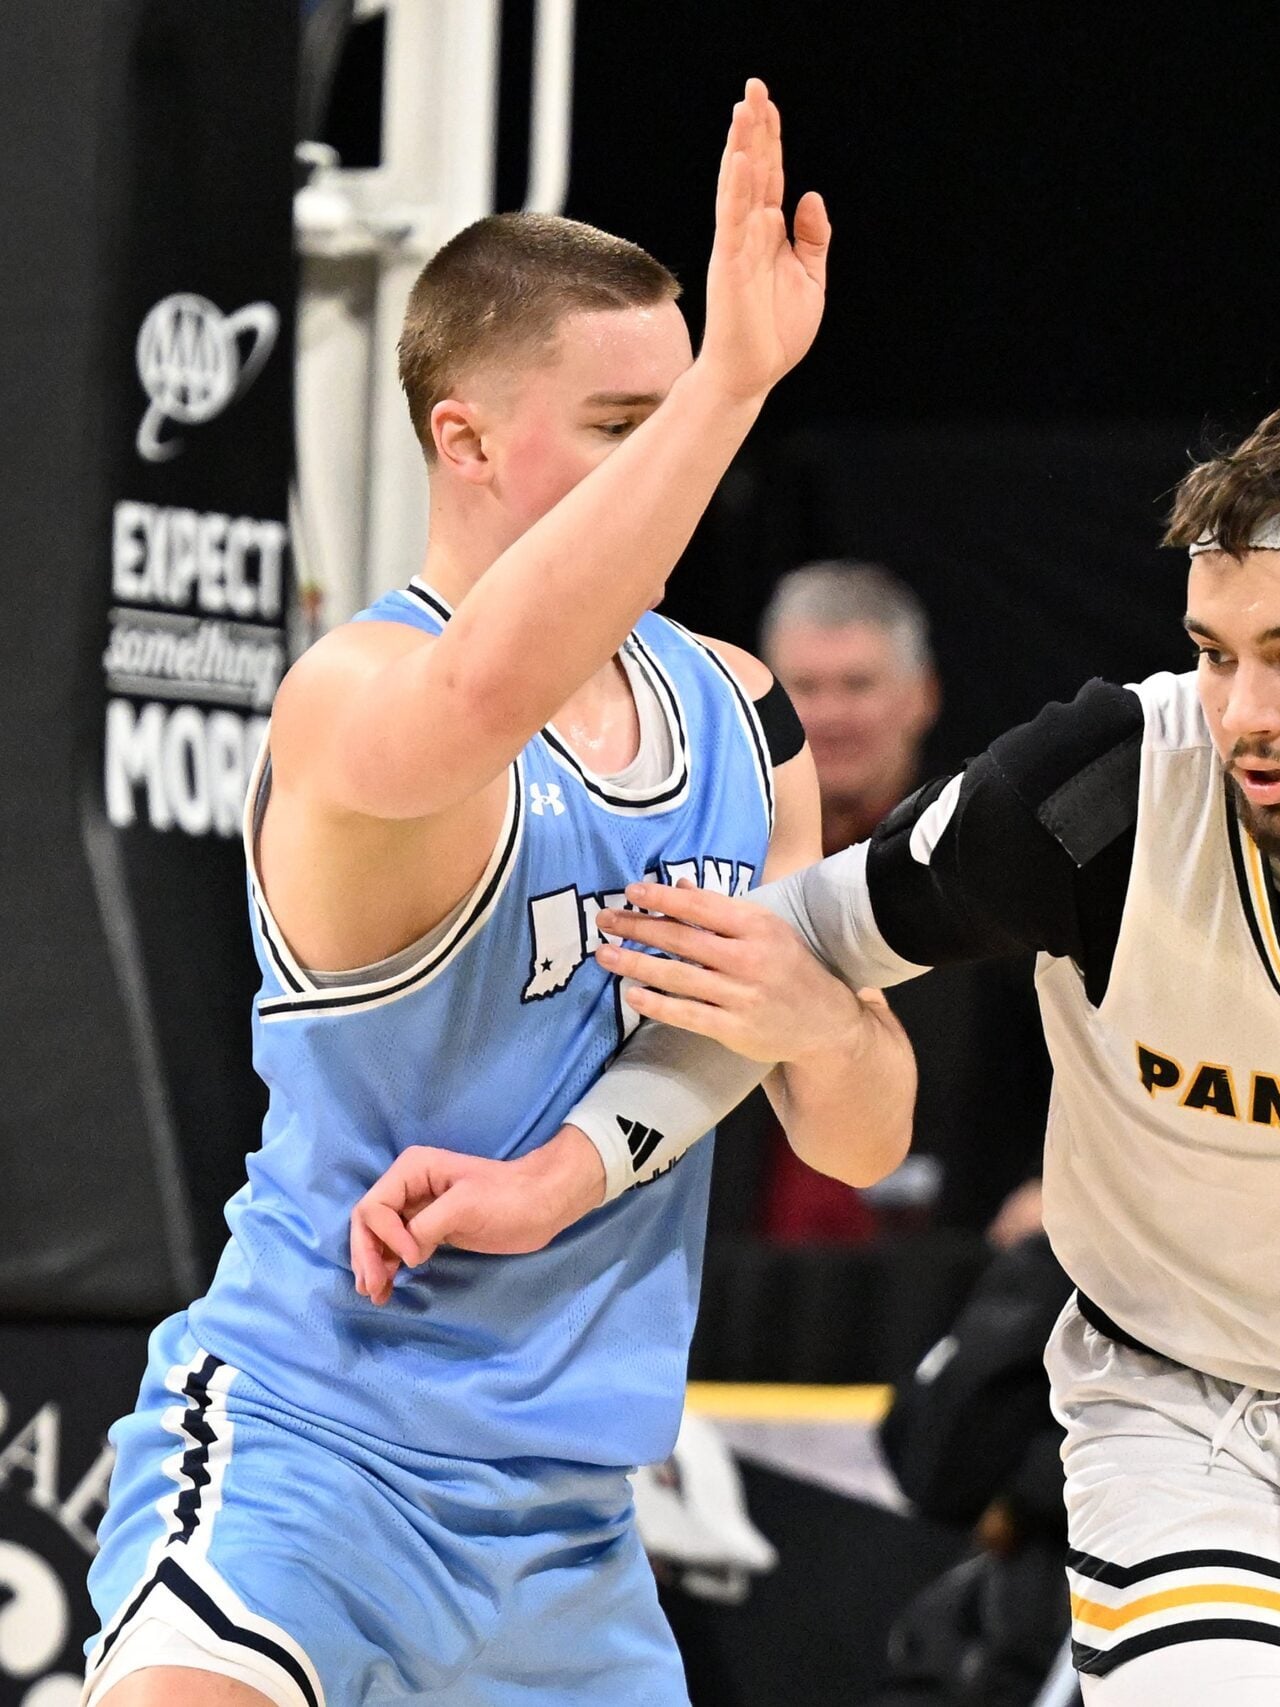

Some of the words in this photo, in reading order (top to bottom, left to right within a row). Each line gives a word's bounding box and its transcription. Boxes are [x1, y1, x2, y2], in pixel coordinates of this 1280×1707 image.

[113, 501, 285, 617] EXPECT
[103, 618, 283, 708] something
[105, 700, 271, 838] MOR
